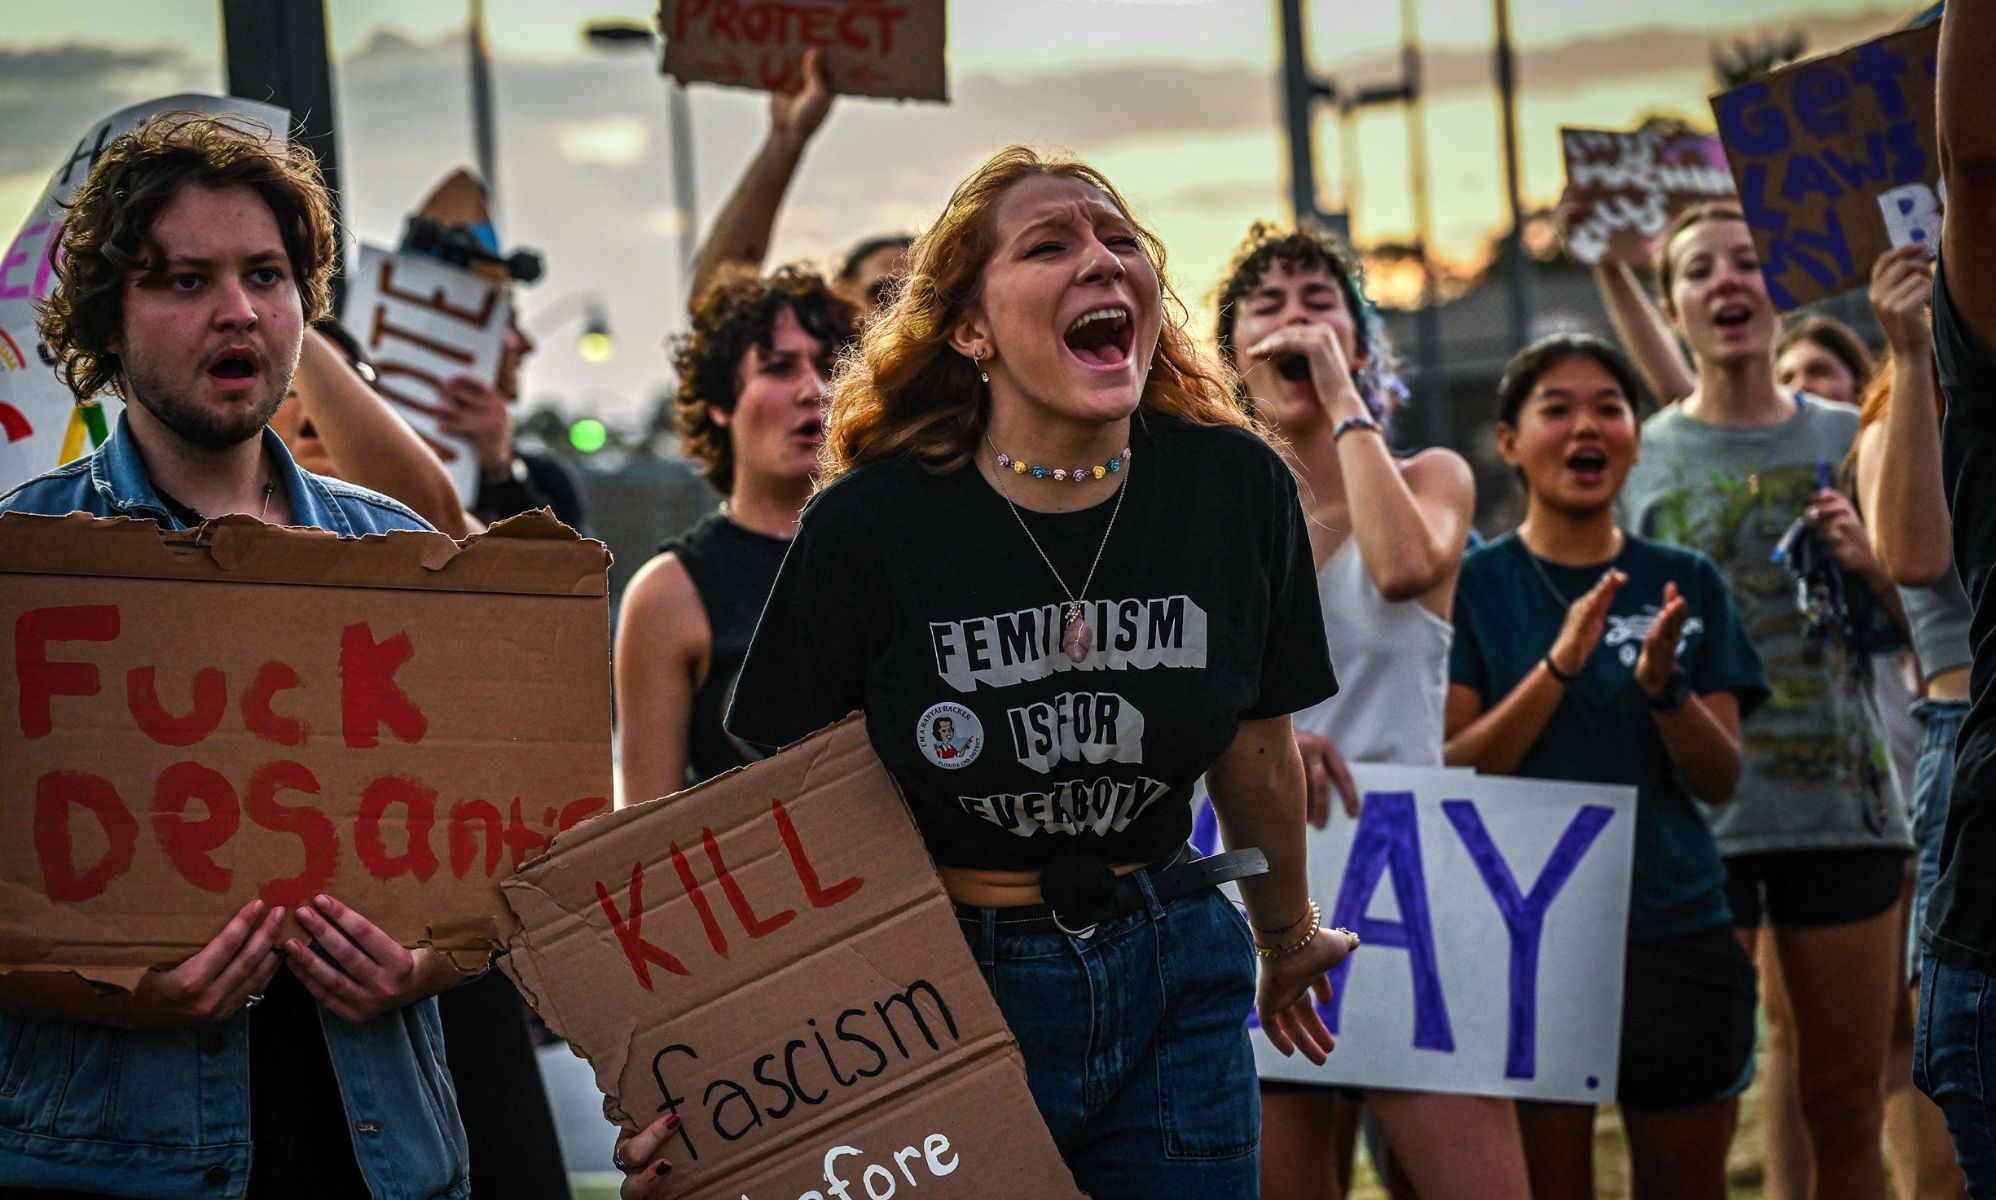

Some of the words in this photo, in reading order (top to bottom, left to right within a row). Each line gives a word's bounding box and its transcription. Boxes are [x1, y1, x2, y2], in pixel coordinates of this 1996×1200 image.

[674, 0, 909, 55] PROTECT
[1742, 121, 1927, 232] LAWS
[1761, 206, 1854, 311] MY
[921, 707, 942, 728] BANYAI
[943, 705, 972, 721] BACKER
[1007, 703, 1057, 770] IS
[1055, 692, 1141, 760] FOR
[596, 798, 865, 992] KILL
[652, 979, 959, 1160] fascism
